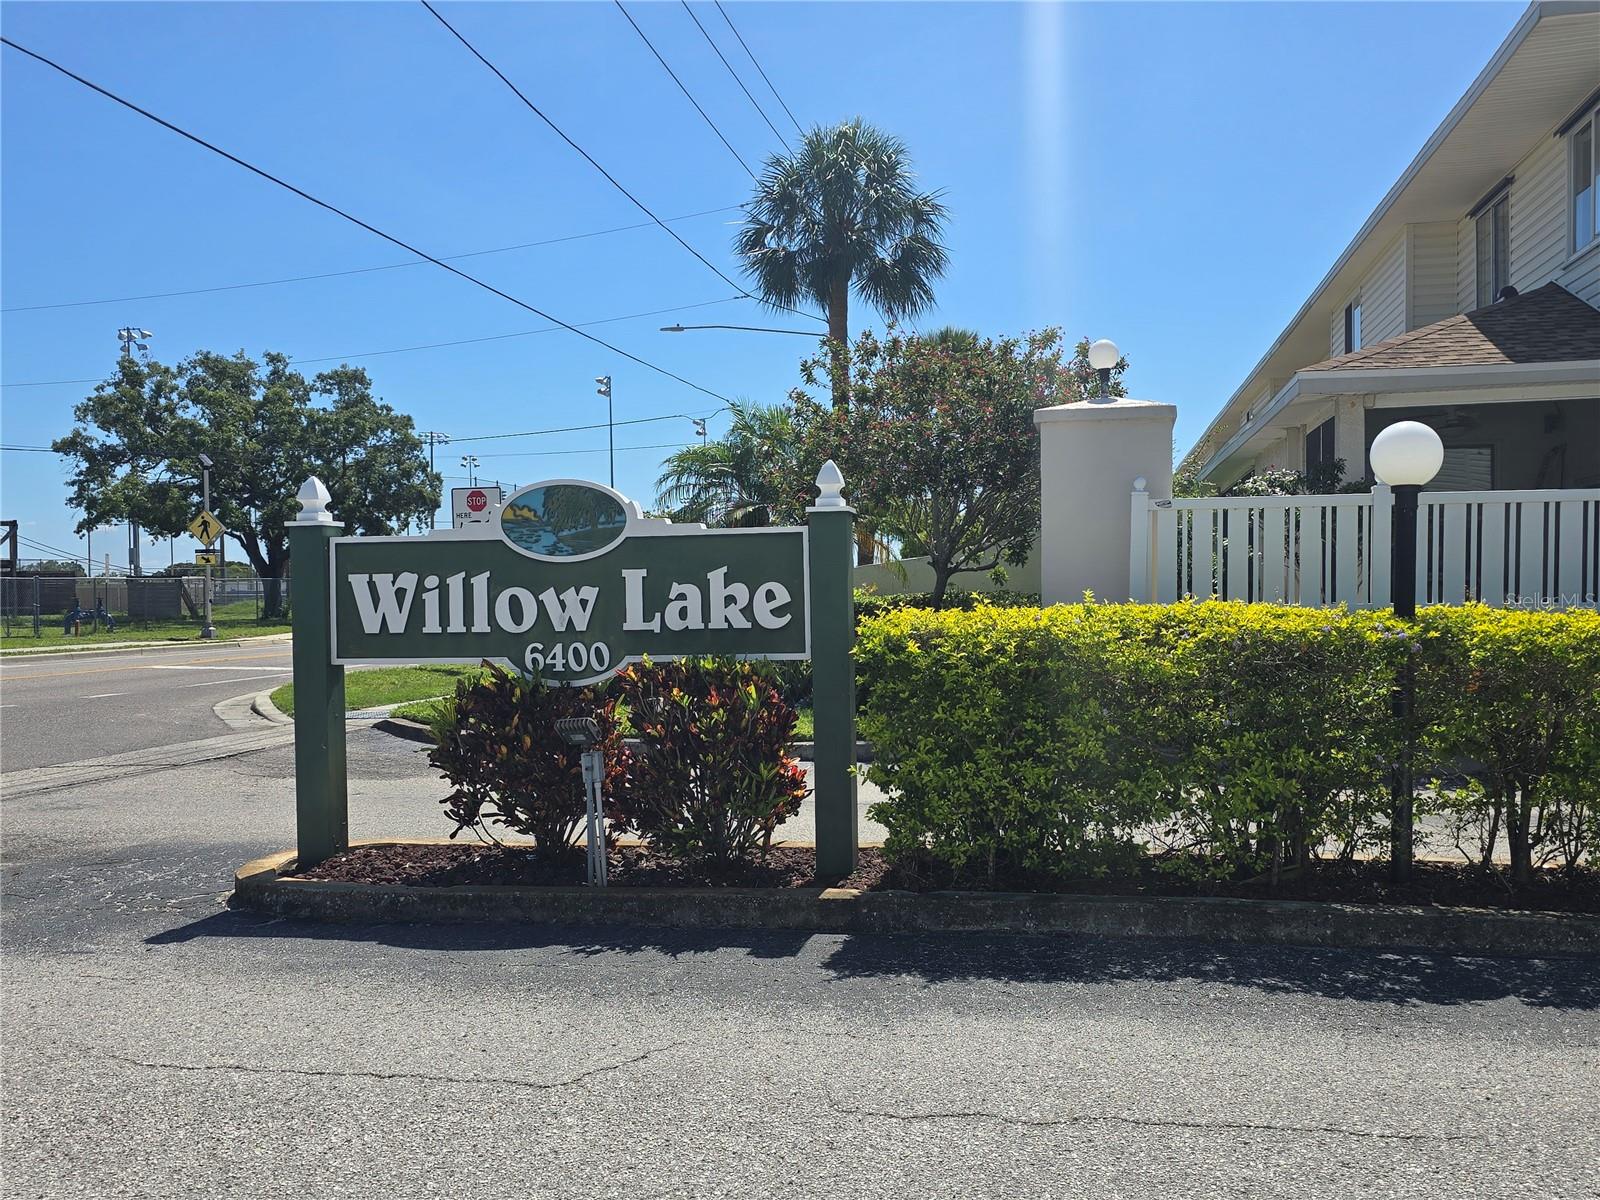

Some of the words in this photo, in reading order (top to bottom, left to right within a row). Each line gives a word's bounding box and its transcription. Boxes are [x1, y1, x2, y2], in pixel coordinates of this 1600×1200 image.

[467, 496, 486, 506] STOP
[348, 570, 600, 634] Willow
[621, 565, 792, 633] Lake
[524, 641, 610, 672] 6400
